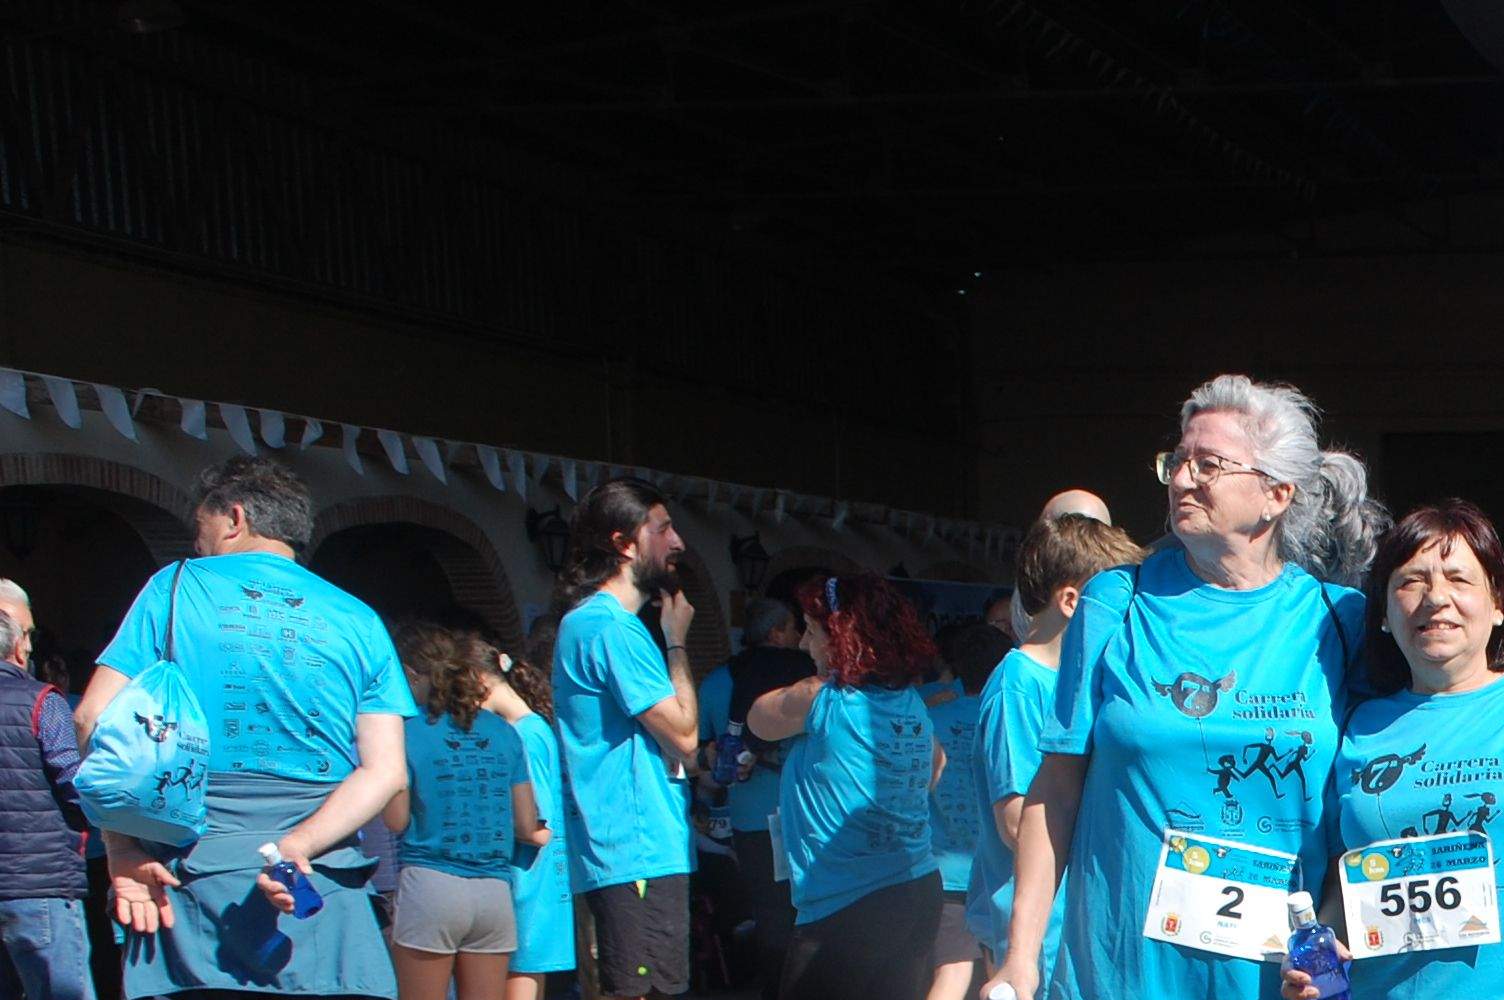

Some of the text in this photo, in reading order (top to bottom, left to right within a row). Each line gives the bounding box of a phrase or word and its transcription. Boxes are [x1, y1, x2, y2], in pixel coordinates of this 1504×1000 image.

[1234, 689, 1307, 705] Carrera
[1232, 704, 1316, 720] solidaria
[1420, 757, 1500, 774] Carrera
[1413, 768, 1504, 789] solidaria
[1445, 856, 1488, 868] MARZO
[1215, 885, 1245, 920] 2
[1380, 876, 1462, 917] 556
